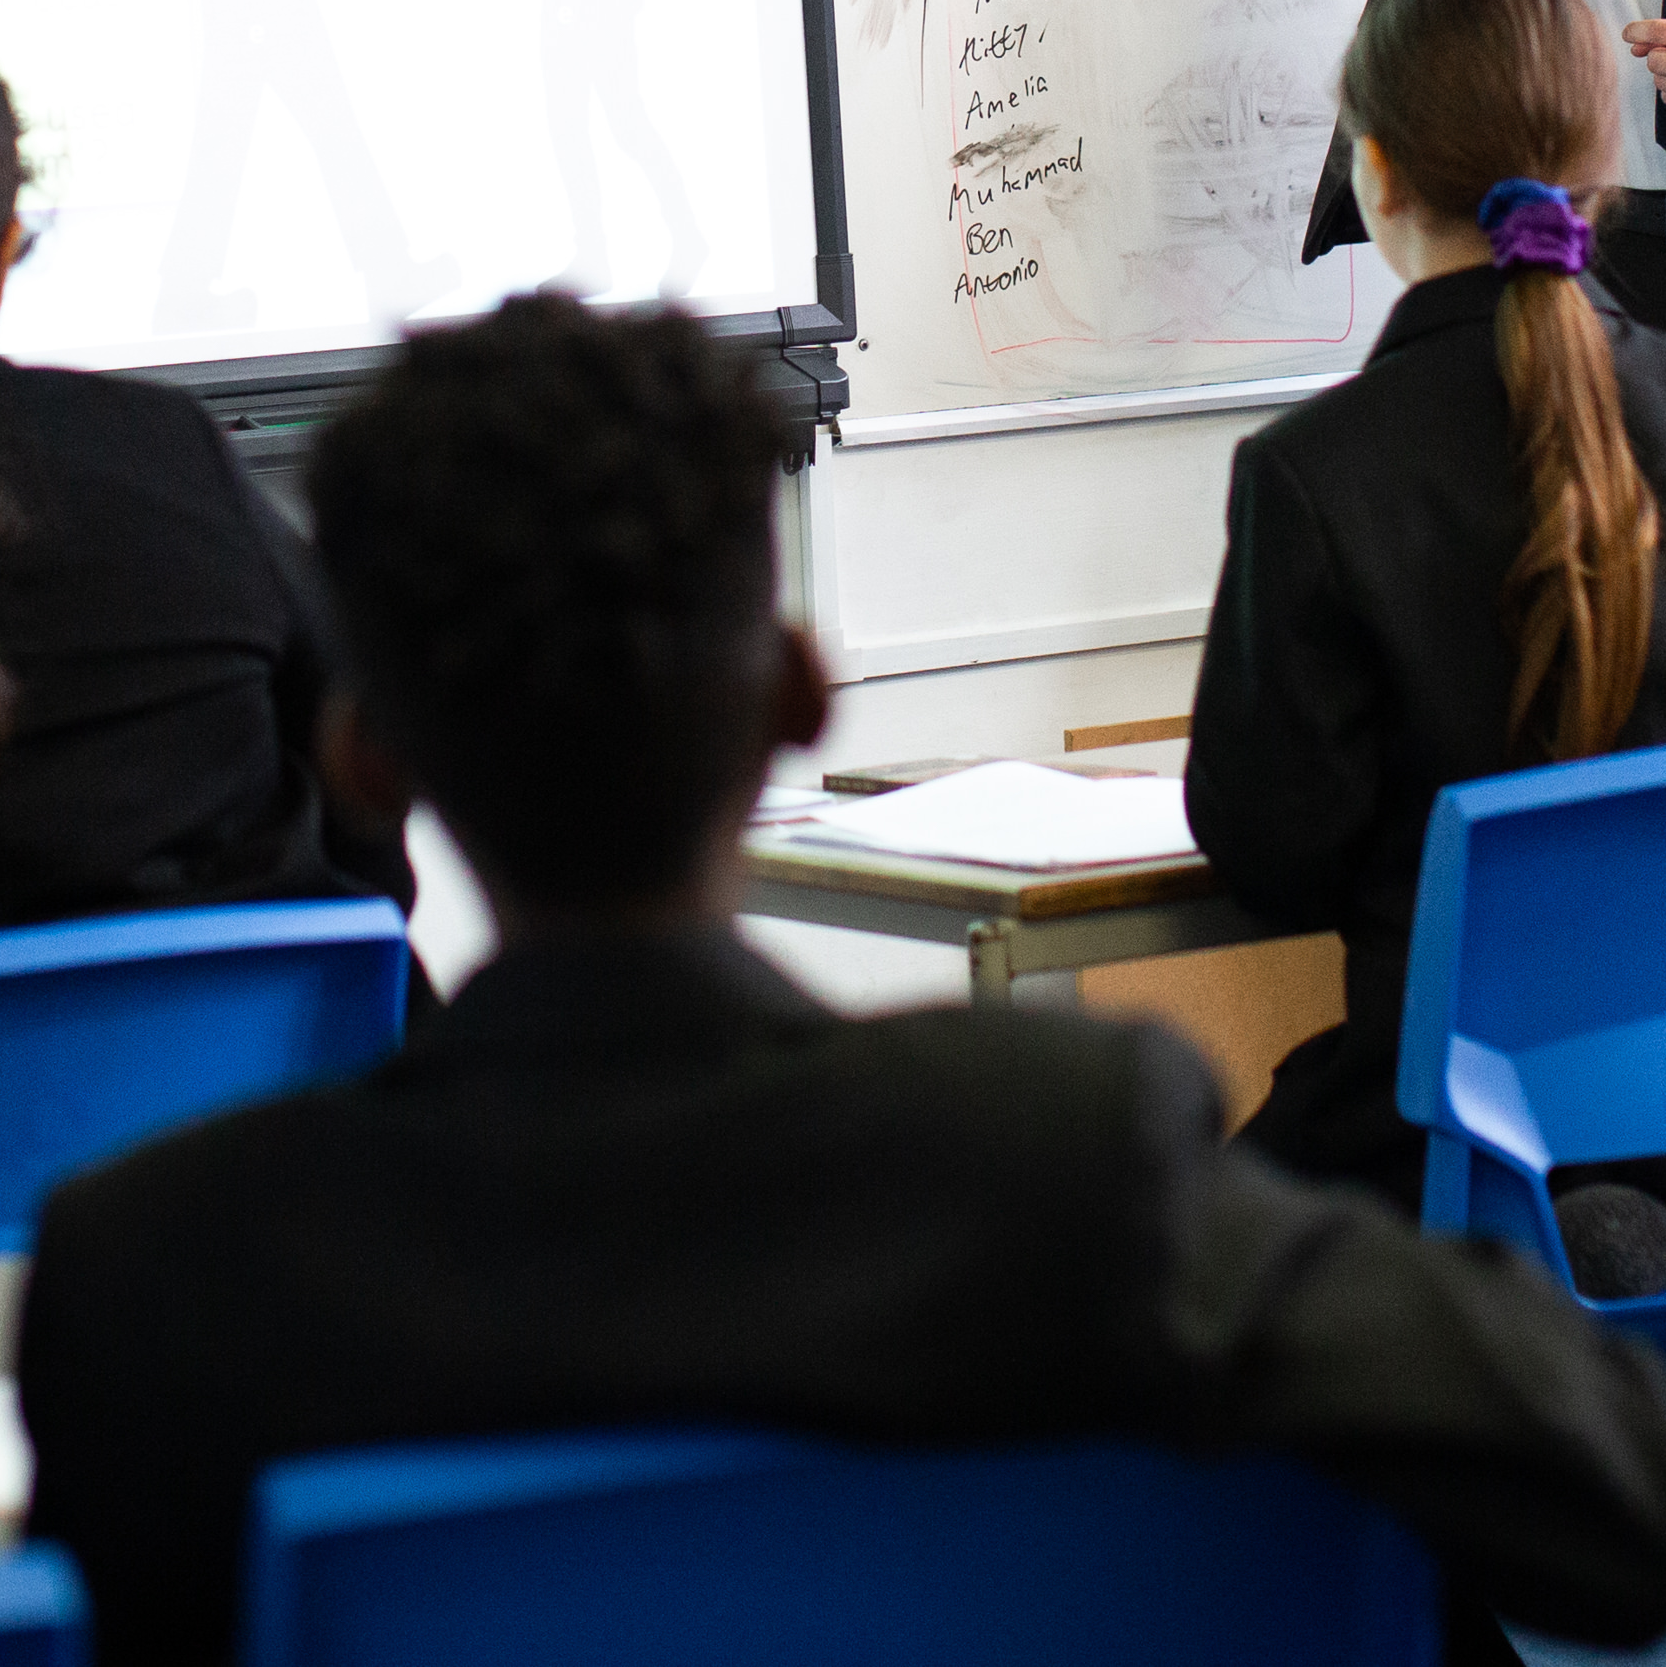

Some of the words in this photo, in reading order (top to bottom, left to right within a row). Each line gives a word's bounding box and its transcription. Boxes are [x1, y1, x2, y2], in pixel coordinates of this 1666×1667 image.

[965, 76, 1048, 130] Amelia
[963, 222, 1014, 256] Ben
[953, 258, 1040, 305] Antonio
